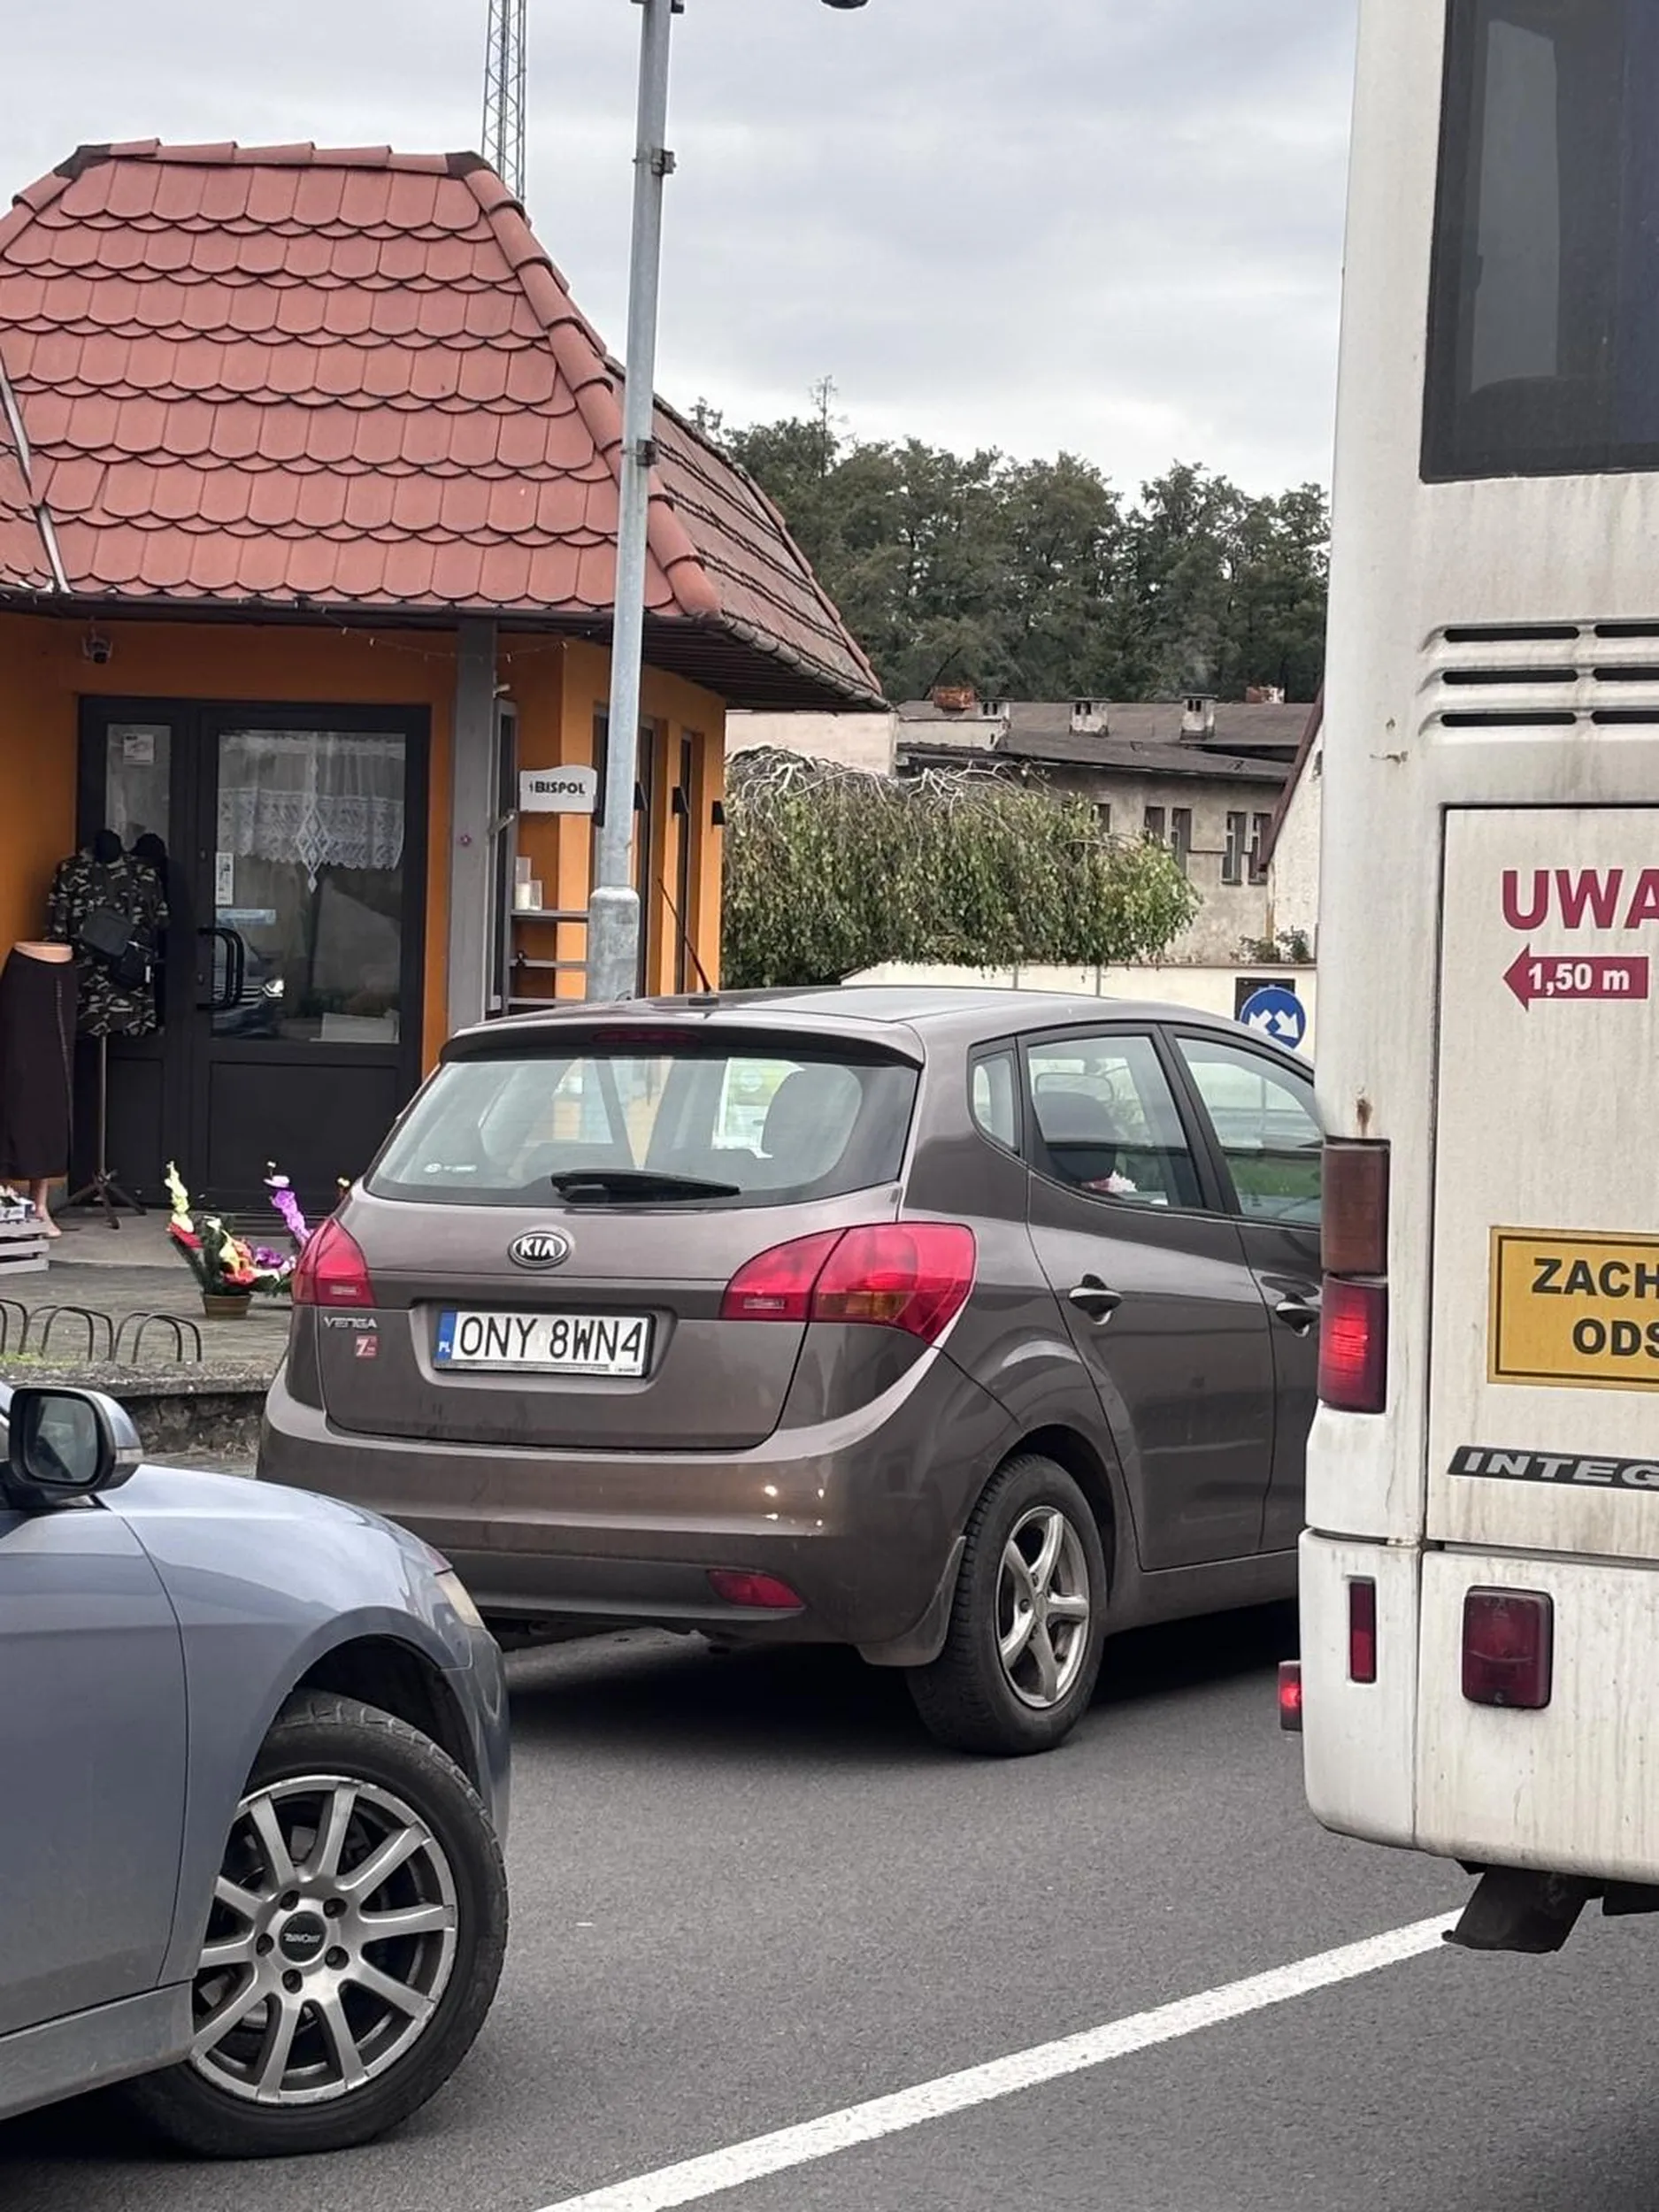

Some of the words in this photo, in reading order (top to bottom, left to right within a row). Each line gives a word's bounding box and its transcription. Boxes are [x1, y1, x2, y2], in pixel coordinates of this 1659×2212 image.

[534, 780, 586, 795] BISPOL
[1502, 869, 1659, 930] UWA
[1528, 963, 1593, 996] 1,50
[1601, 969, 1630, 991] m
[519, 1238, 556, 1256] KIA
[1532, 1257, 1659, 1299] ZACH
[438, 1340, 450, 1354] PL
[459, 1316, 538, 1357] ONY
[549, 1318, 643, 1363] 8WN4
[1463, 1452, 1659, 1486] INTEG
